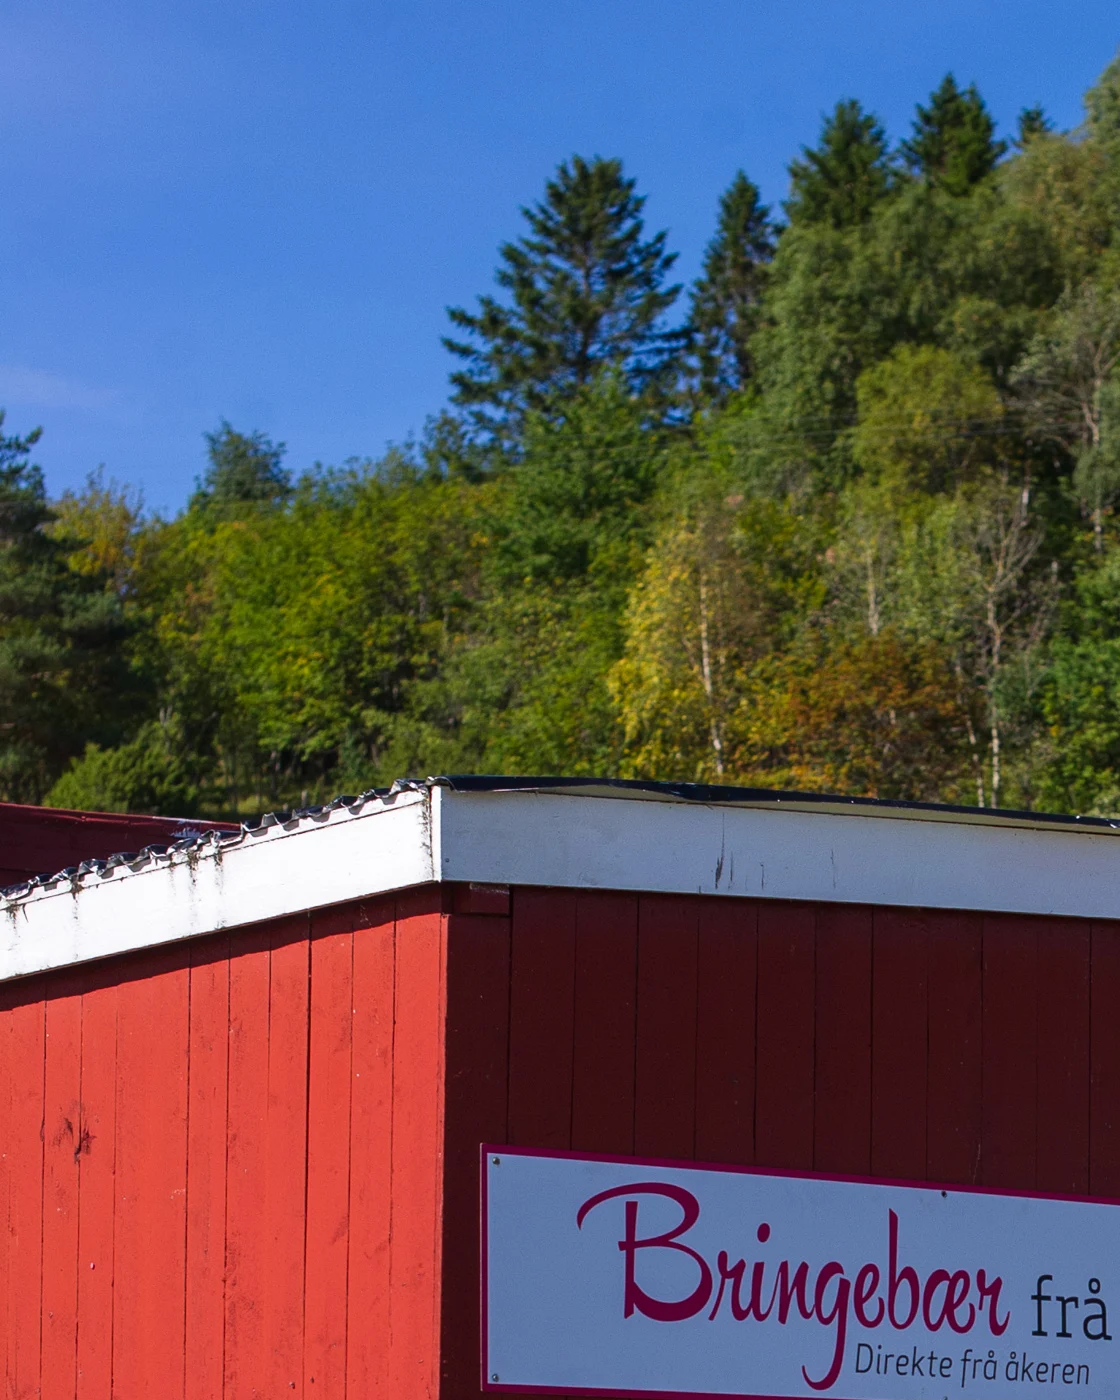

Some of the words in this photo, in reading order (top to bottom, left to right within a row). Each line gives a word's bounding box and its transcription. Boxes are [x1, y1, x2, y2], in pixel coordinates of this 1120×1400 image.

[577, 1182, 1010, 1390] Bringebær
[1031, 1275, 1112, 1341] frå
[855, 1343, 952, 1378] Direkte
[960, 1349, 997, 1387] frå
[1005, 1351, 1090, 1385] åkeren
